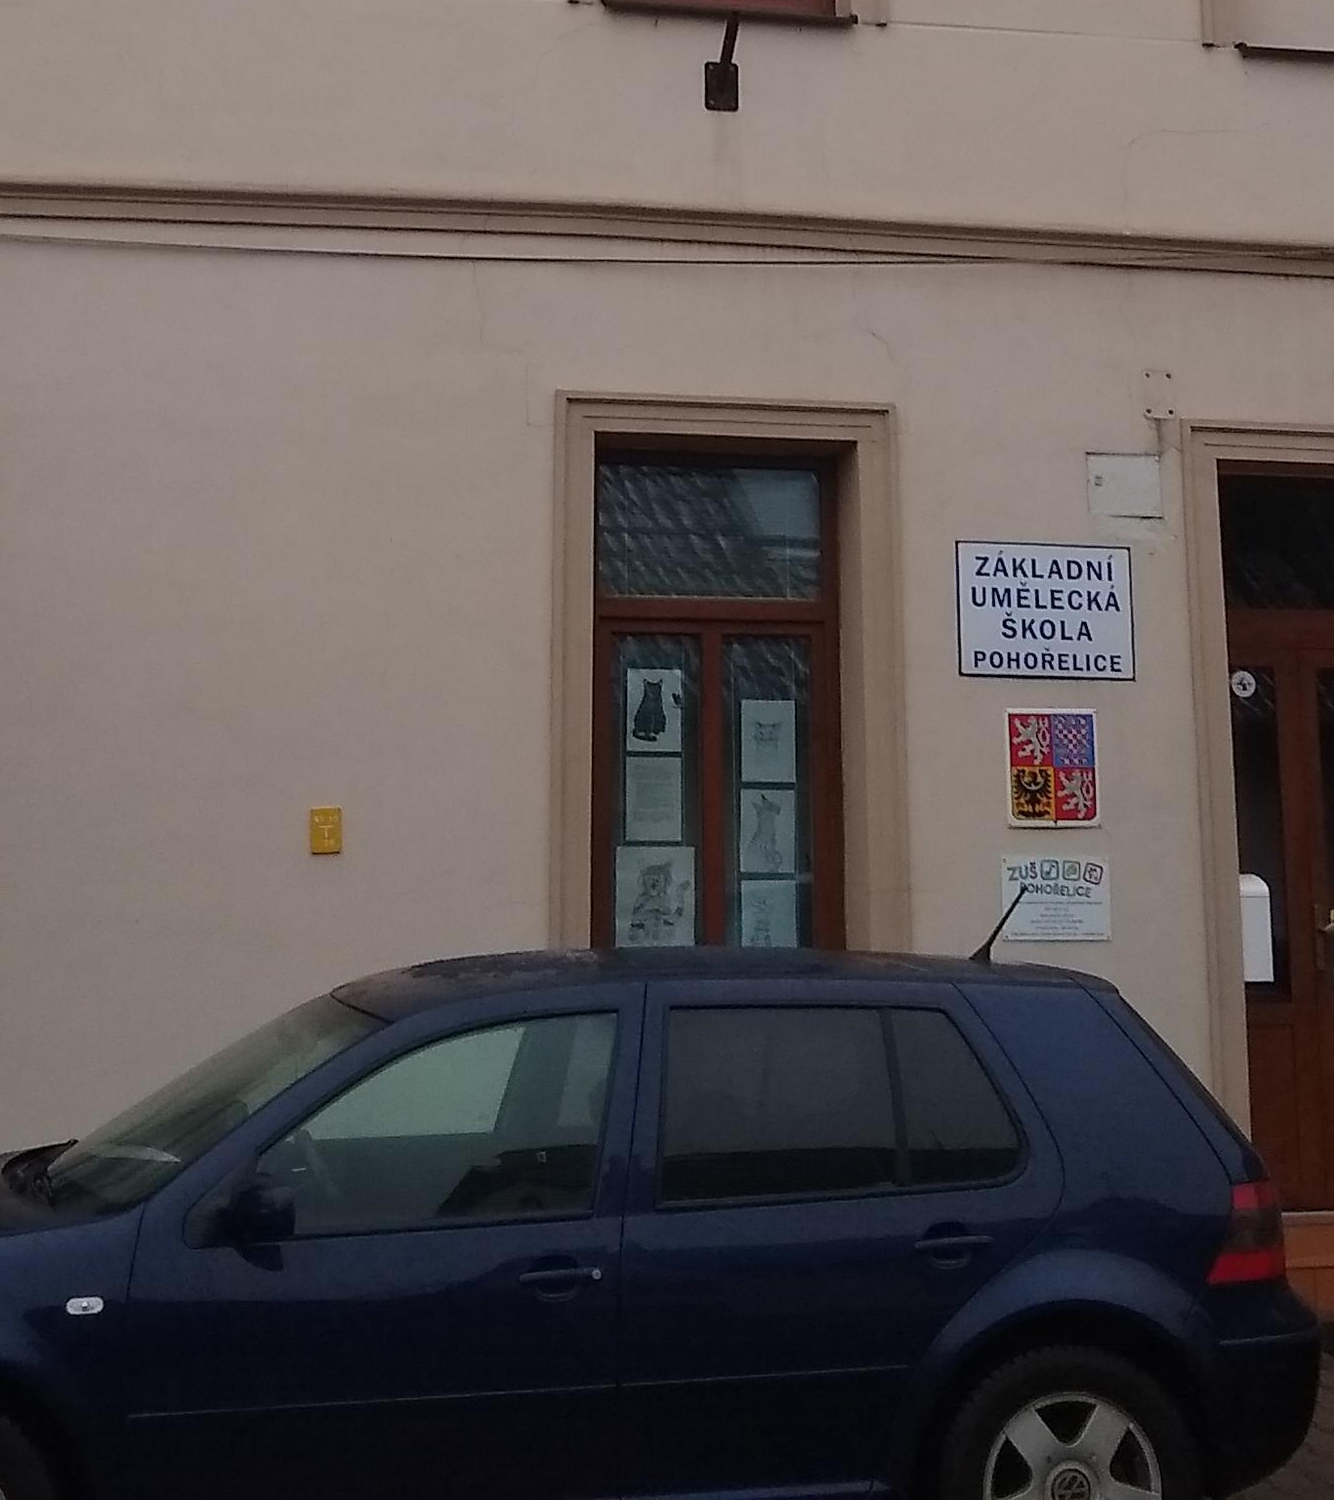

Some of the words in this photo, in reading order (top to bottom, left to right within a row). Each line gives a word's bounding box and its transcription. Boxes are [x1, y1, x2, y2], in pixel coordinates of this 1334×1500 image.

[974, 550, 1114, 582] ZÁKLADNÍ
[971, 581, 1121, 613] UMĚLECKÁ
[1001, 611, 1093, 642] ŠKOLA
[973, 647, 1123, 673] POHOŘELICE
[1007, 861, 1038, 881] ZUŠ
